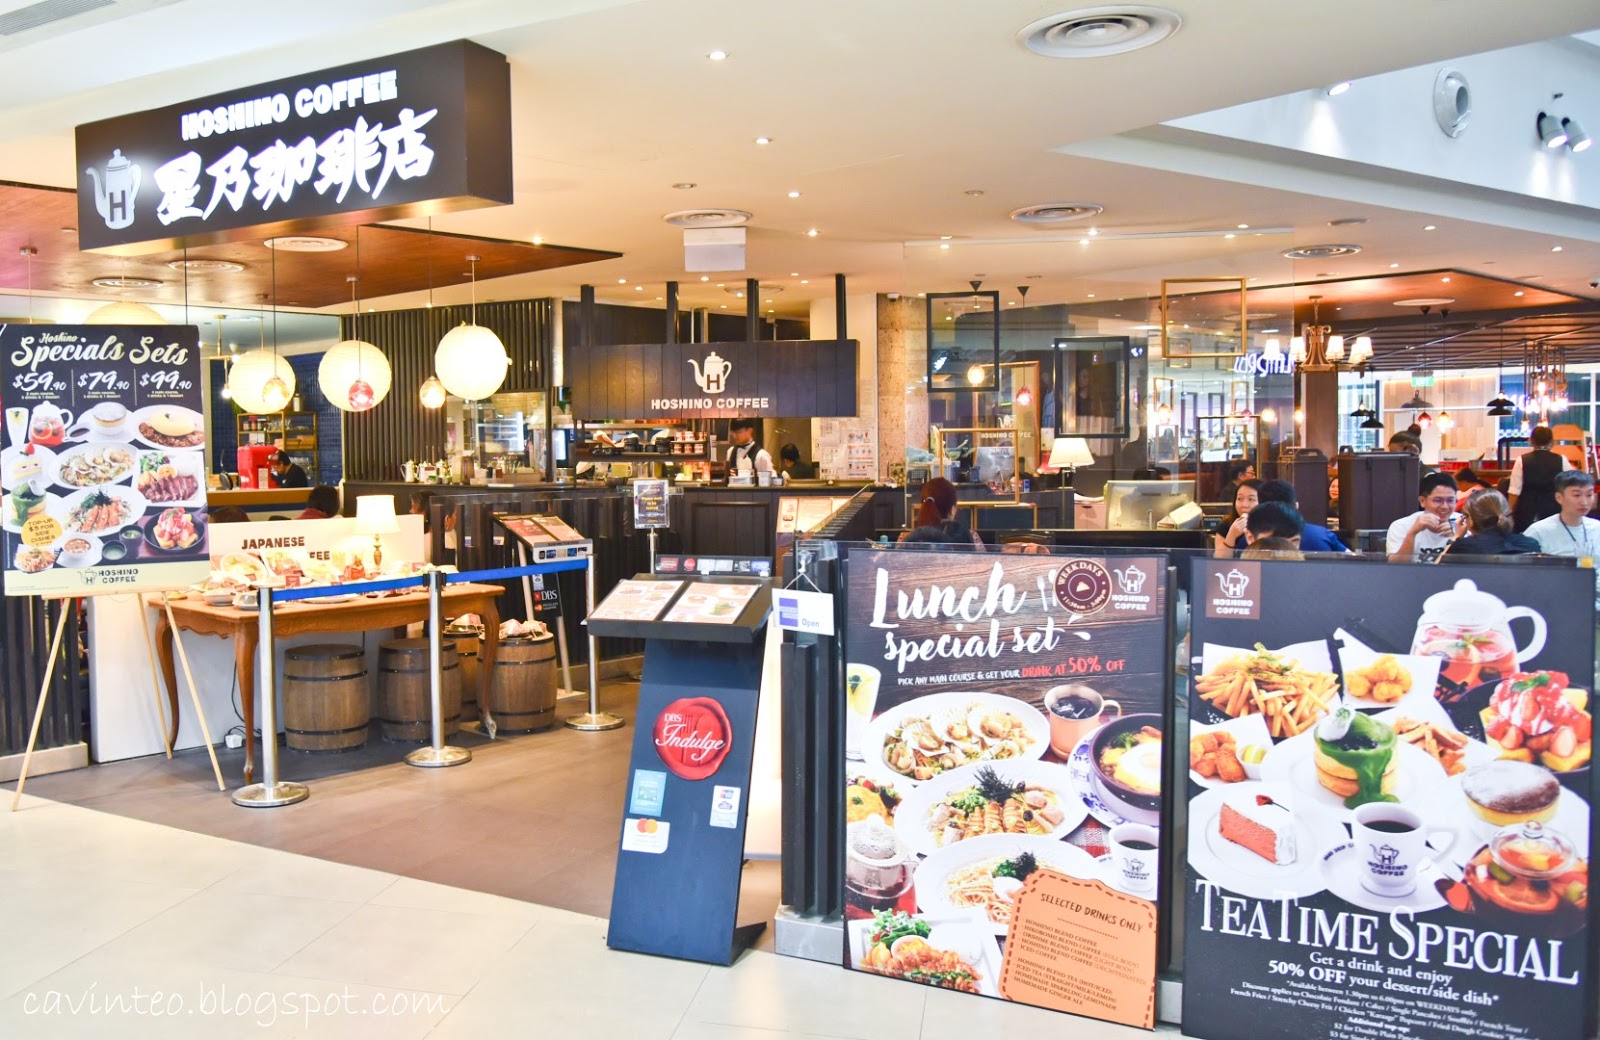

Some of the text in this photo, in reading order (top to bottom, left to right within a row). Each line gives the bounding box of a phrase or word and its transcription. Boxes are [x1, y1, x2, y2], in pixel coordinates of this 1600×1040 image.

[182, 70, 398, 140] HOSHINO COFFEE
[154, 108, 438, 226] 星乃珈琲店
[109, 190, 127, 222] H
[39, 333, 79, 344] Hoshino
[11, 335, 189, 372] Specials Sets
[12, 370, 192, 391] $59.90 $79.90 $99.90
[706, 374, 720, 390] H
[651, 398, 768, 410] HOSHINO COFFEE
[241, 536, 305, 550] JAPANESE
[102, 576, 136, 584] COFFEE
[1057, 562, 1103, 585] WEEKDAYS
[541, 590, 558, 600] DBS
[870, 561, 1027, 628] Lunch
[1112, 594, 1150, 602] HOSHINO
[1213, 599, 1253, 607] HOSHINO
[1115, 603, 1147, 611] COFFEE
[1216, 607, 1250, 615] COFFEE
[802, 618, 820, 628] Open
[883, 616, 1065, 673] special set
[898, 655, 1125, 686] PICK ANY MAIN COURSE & GET YOUR DRINK AT 50% OFF
[664, 713, 682, 722] DBS
[655, 723, 726, 761] Indulge
[1367, 861, 1408, 870] HOSHINO
[1371, 868, 1404, 876] COFFEE
[1040, 893, 1143, 932] SELECTED DRINKS ONLY
[1026, 919, 1098, 946] HOSHINO BLEND COFFEE
[1020, 944, 1056, 960] ICED COFFEE
[1022, 938, 1050, 950] HOSHINO
[1050, 948, 1070, 958] BLEND
[1071, 955, 1092, 966] COFFEE
[1050, 941, 1070, 951] BLEND
[1070, 948, 1092, 959] COFFEE
[1058, 936, 1078, 947] BLEND
[1079, 944, 1101, 955] COFFEE
[1389, 905, 1579, 986] SPECIAL
[1016, 964, 1030, 972] ICED
[1018, 957, 1046, 970] HOSHINO
[1046, 968, 1066, 978] BLEND
[1309, 952, 1453, 986] Get a drink and enjoy
[1015, 970, 1117, 1010] HOMEMADE SPARKLING LEMONADE
[1268, 960, 1304, 977] 50%
[1309, 966, 1346, 984] OFF
[1348, 975, 1381, 987] your
[1383, 978, 1460, 1000] dessert/side
[1014, 976, 1083, 1006] HOMEMADE GINGER ALE
[1416, 1001, 1460, 1014] WEEKDAYS
